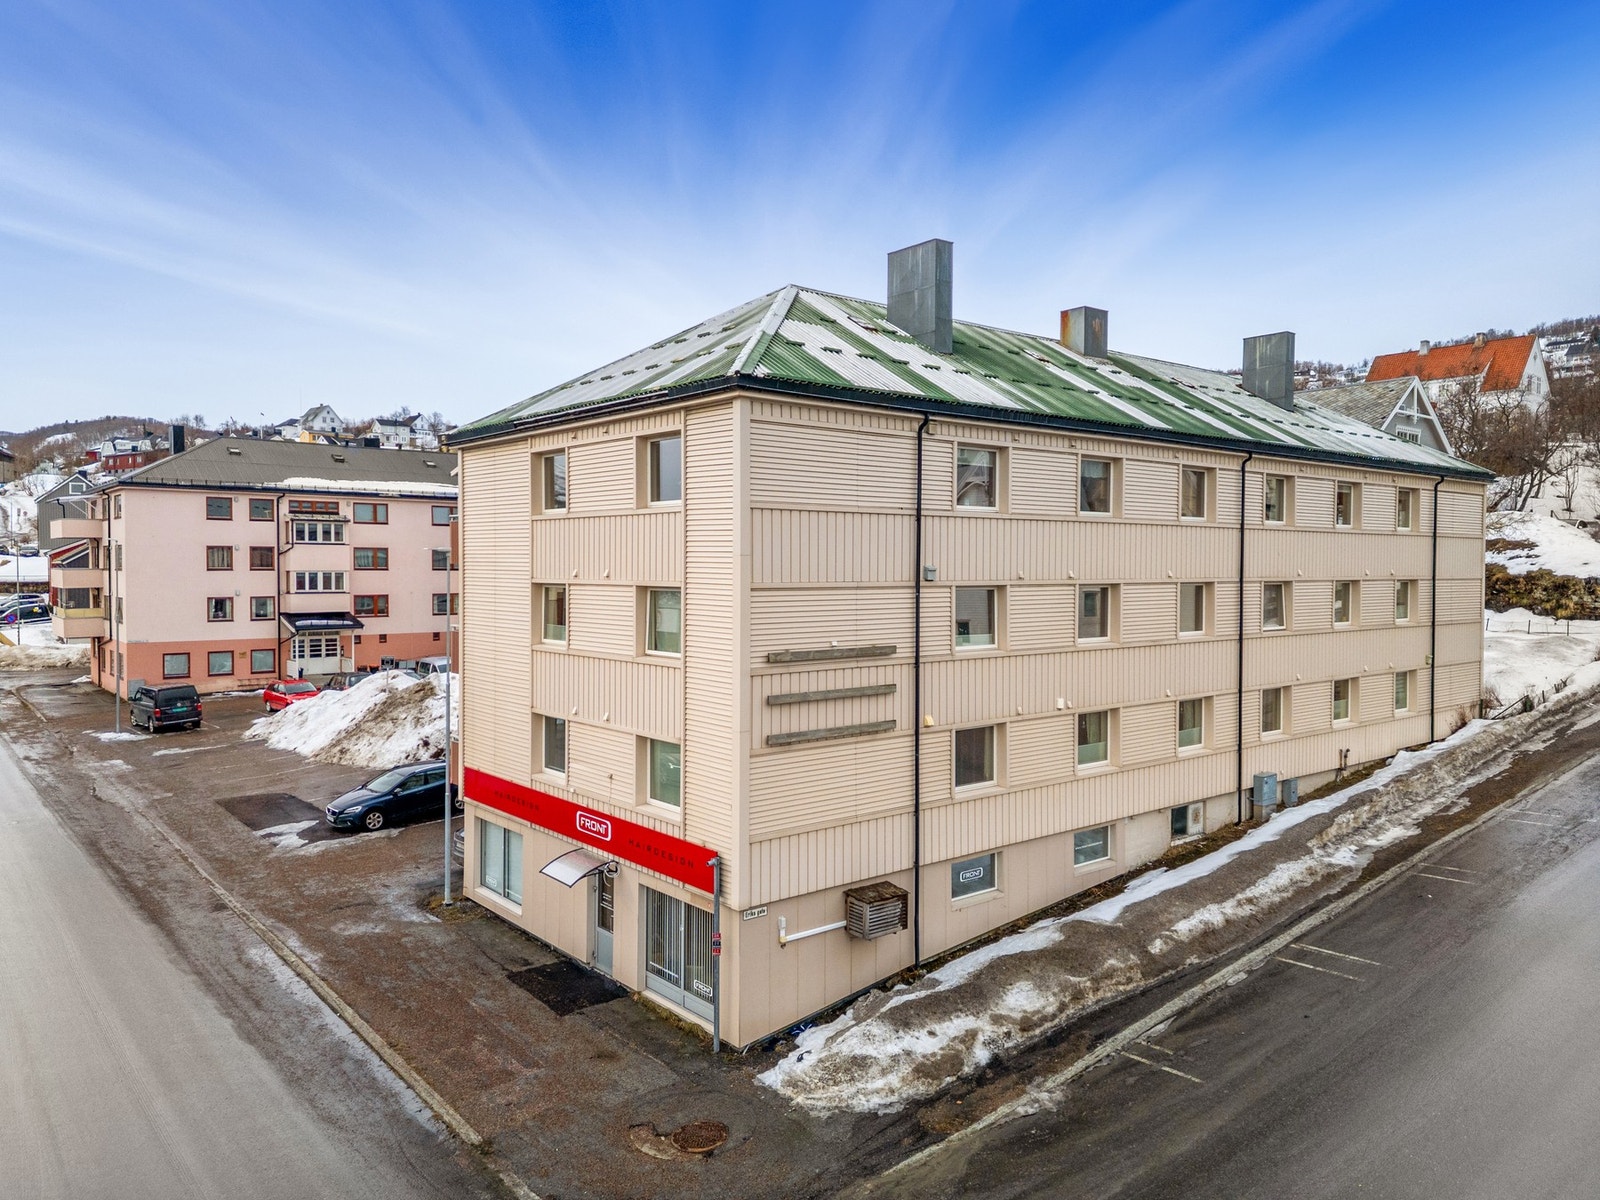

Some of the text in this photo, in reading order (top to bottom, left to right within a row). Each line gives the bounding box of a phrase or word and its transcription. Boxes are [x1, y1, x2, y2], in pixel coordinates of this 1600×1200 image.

[580, 817, 607, 835] FRONT
[628, 839, 693, 867] HAIRDESIGN
[962, 869, 980, 879] FRONT
